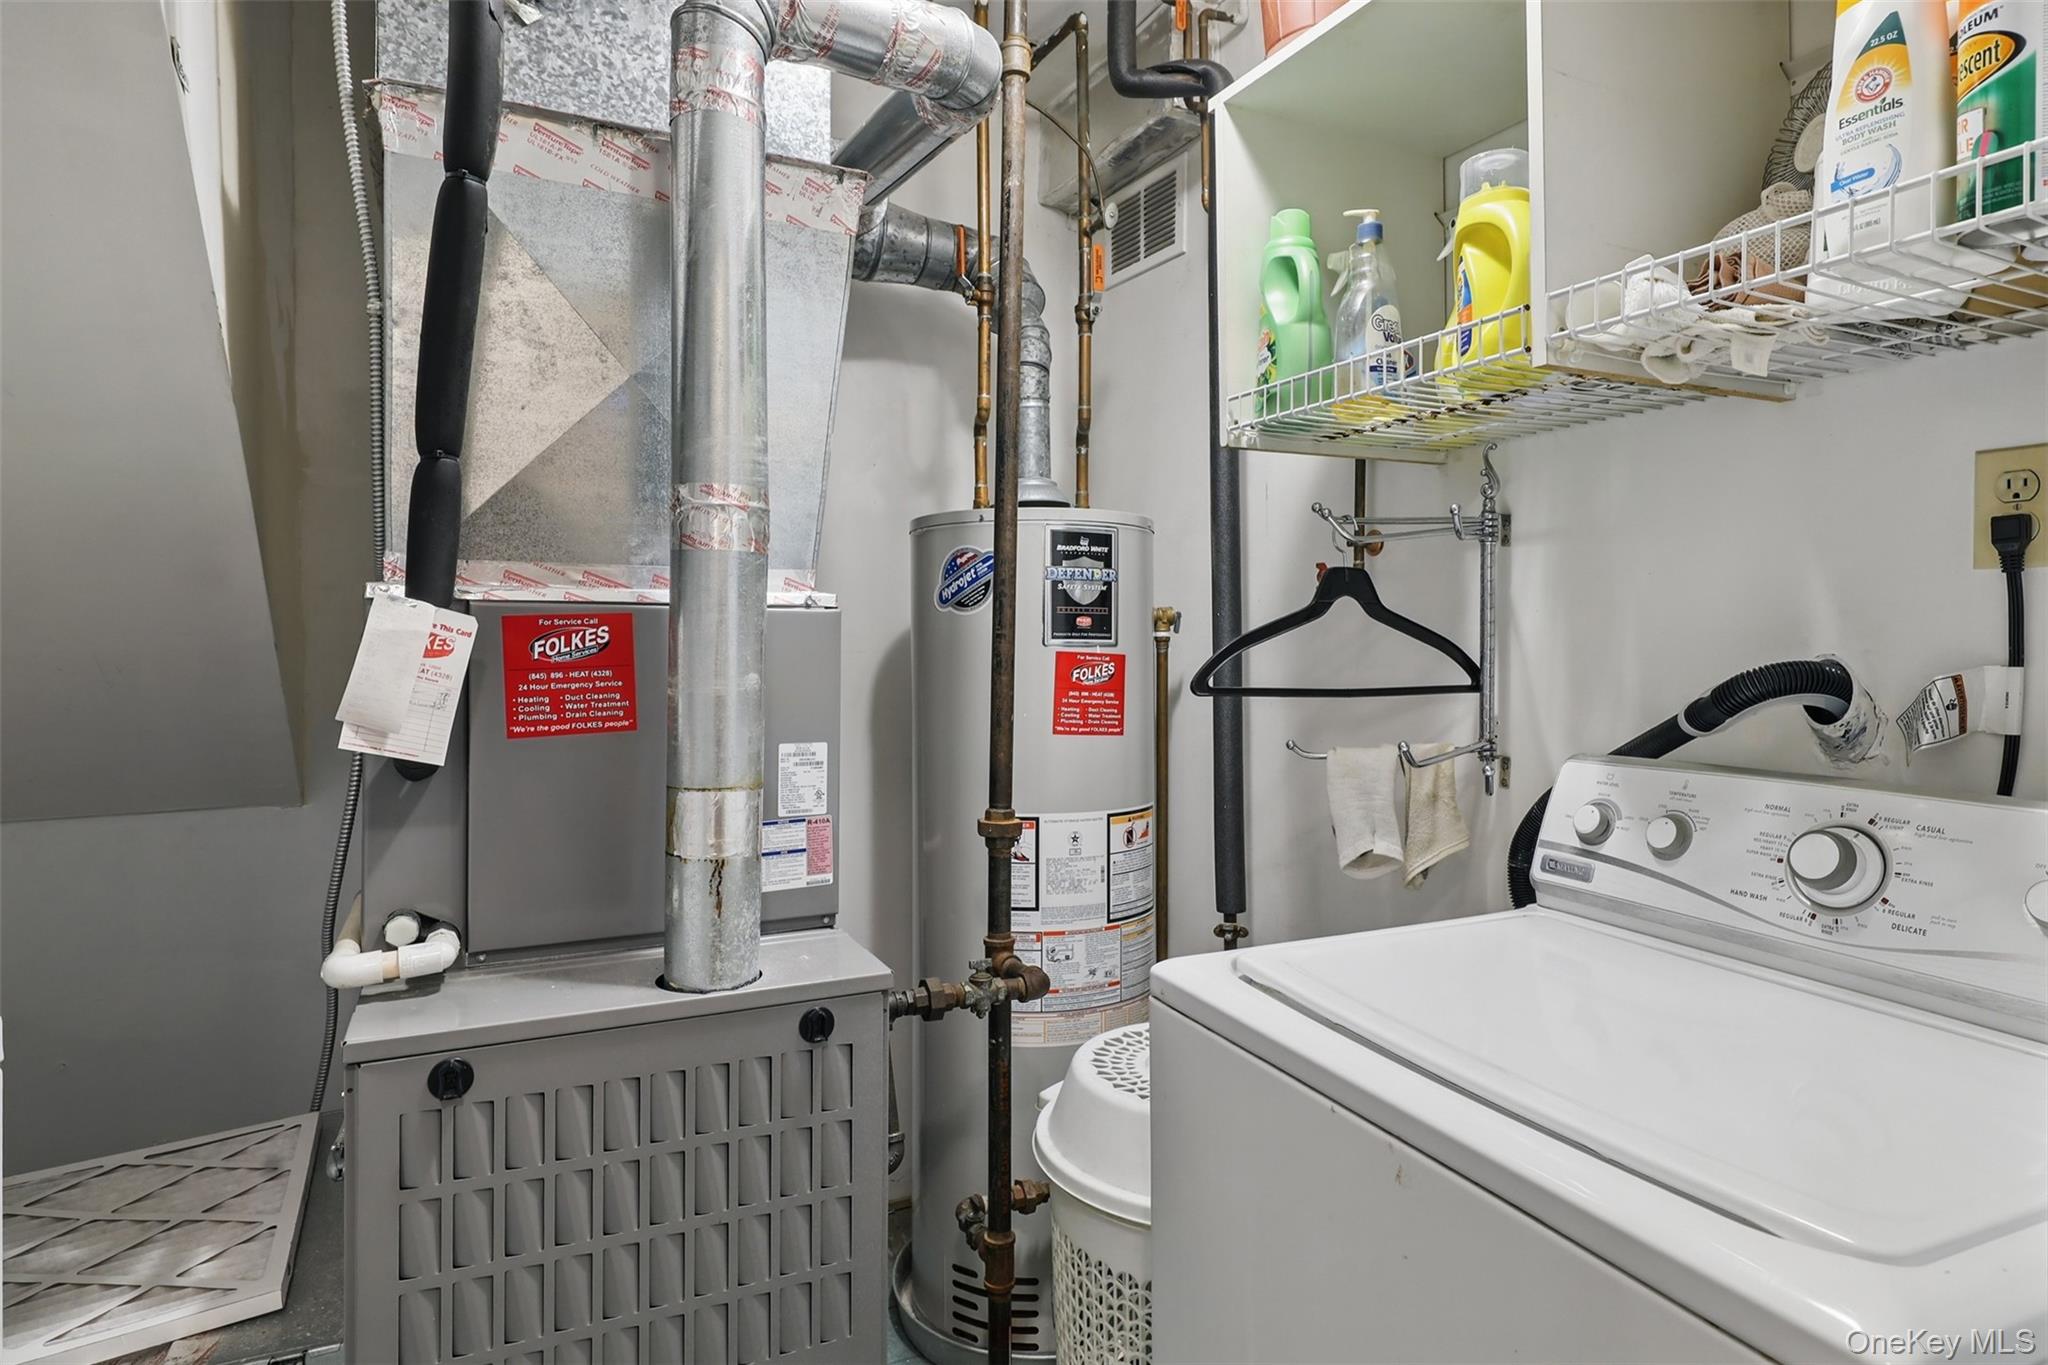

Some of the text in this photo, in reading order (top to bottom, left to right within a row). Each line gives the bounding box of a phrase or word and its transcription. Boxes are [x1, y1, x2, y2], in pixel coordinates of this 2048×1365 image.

[1870, 30, 1898, 47] 22.5 OZ
[1959, 39, 2001, 82] escent
[1839, 97, 1903, 130] Essentials
[1842, 120, 1896, 145] BODY WASH
[1046, 567, 1117, 582] DEFENDER
[941, 567, 976, 601] Hydrojet
[538, 617, 599, 626] For Service Call
[439, 624, 454, 633] This
[456, 629, 473, 638] Card
[427, 635, 454, 651] KES
[533, 625, 610, 660] FOLKES
[528, 673, 547, 681] (845)
[569, 671, 590, 679] HEAT
[1072, 662, 1115, 682] FOLKES
[518, 680, 623, 692] 24 Hour Emergency Service
[517, 696, 550, 704] Heating
[585, 692, 620, 700] Cleaning
[517, 705, 551, 713] Cooling
[590, 701, 630, 709] Treatment
[518, 713, 558, 722] Plumbing
[565, 709, 624, 719] Drain Cleaning
[550, 723, 570, 731] good
[571, 721, 603, 729] FOLKES
[1764, 803, 1791, 813] NORMAL
[1916, 824, 1945, 834] CASUAL
[1730, 888, 1768, 901] HAND WASH
[1888, 909, 1916, 919] REGULAR
[1891, 923, 1928, 936] DELICATE
